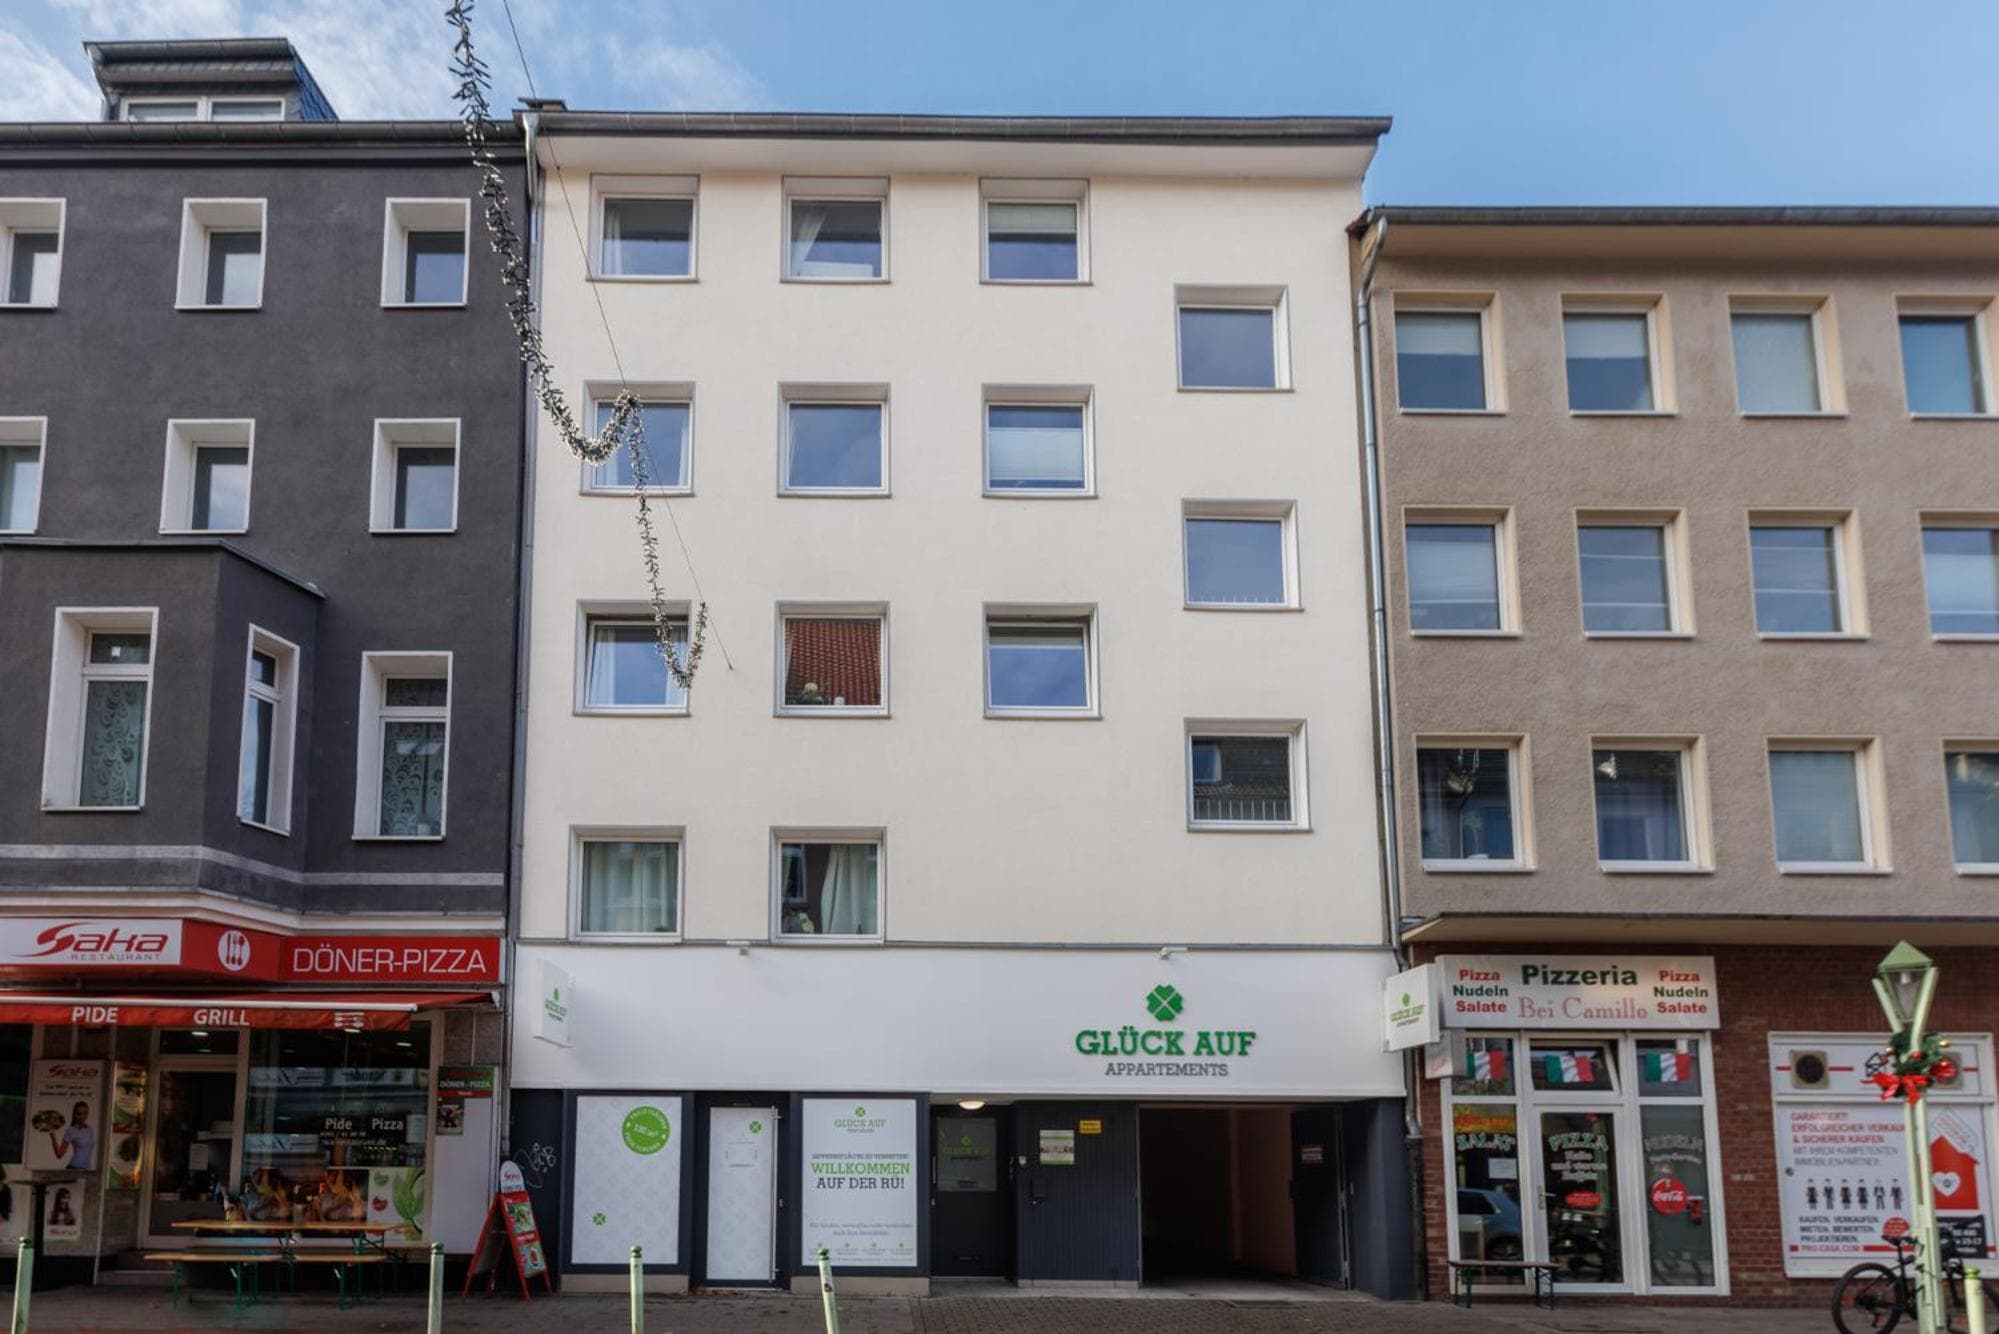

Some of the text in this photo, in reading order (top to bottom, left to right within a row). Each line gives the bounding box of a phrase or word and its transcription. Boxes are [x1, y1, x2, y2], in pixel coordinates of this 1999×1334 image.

[70, 953, 161, 961] RESTAURANT
[293, 943, 487, 974] DÖNER-PIZZA
[1459, 969, 1501, 982] Pizza
[1521, 964, 1638, 986] Pizzeria
[1658, 970, 1700, 982] Pizza
[1453, 985, 1509, 997] Nudeln
[1653, 985, 1709, 999] Nudeln
[1455, 1000, 1507, 1014] Salate
[1518, 996, 1649, 1019] Bei Camillo
[1656, 1001, 1708, 1015] Salate
[71, 1006, 251, 1026] PIDE GRILL
[1075, 1026, 1257, 1057] GLÜCK AUF
[1105, 1062, 1229, 1077] APPARTEMENTS
[325, 1117, 404, 1131] Pide Pizza
[1549, 1132, 1609, 1152] PIZZA
[811, 1162, 911, 1175] WILLKOMMEN
[816, 1175, 905, 1189] AUF DER RÜ!
